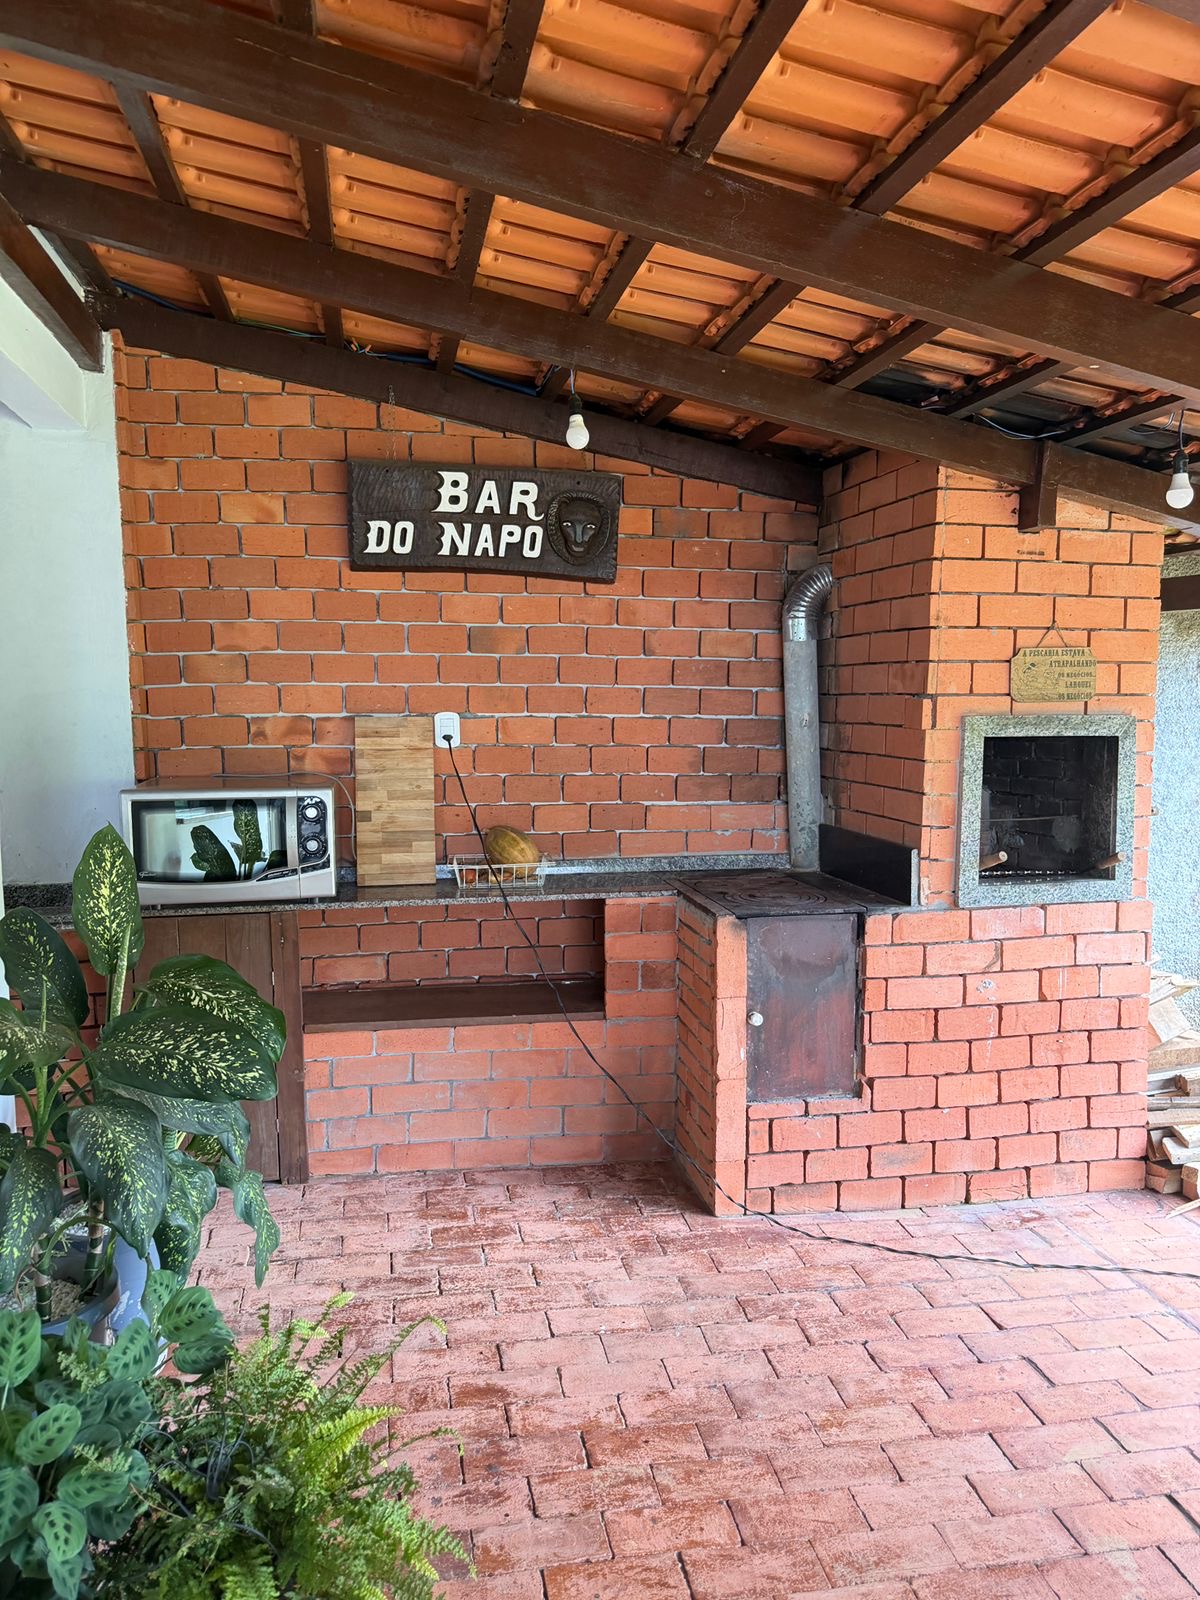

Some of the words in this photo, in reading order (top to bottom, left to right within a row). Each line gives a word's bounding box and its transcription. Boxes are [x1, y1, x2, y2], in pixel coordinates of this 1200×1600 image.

[431, 471, 545, 521] BAR
[363, 520, 415, 555] DO
[437, 521, 544, 558] NAPO
[1029, 649, 1059, 657] PESCARIA
[1061, 649, 1085, 657] ESTAVA
[1049, 660, 1096, 668] ATRAPALHANDO
